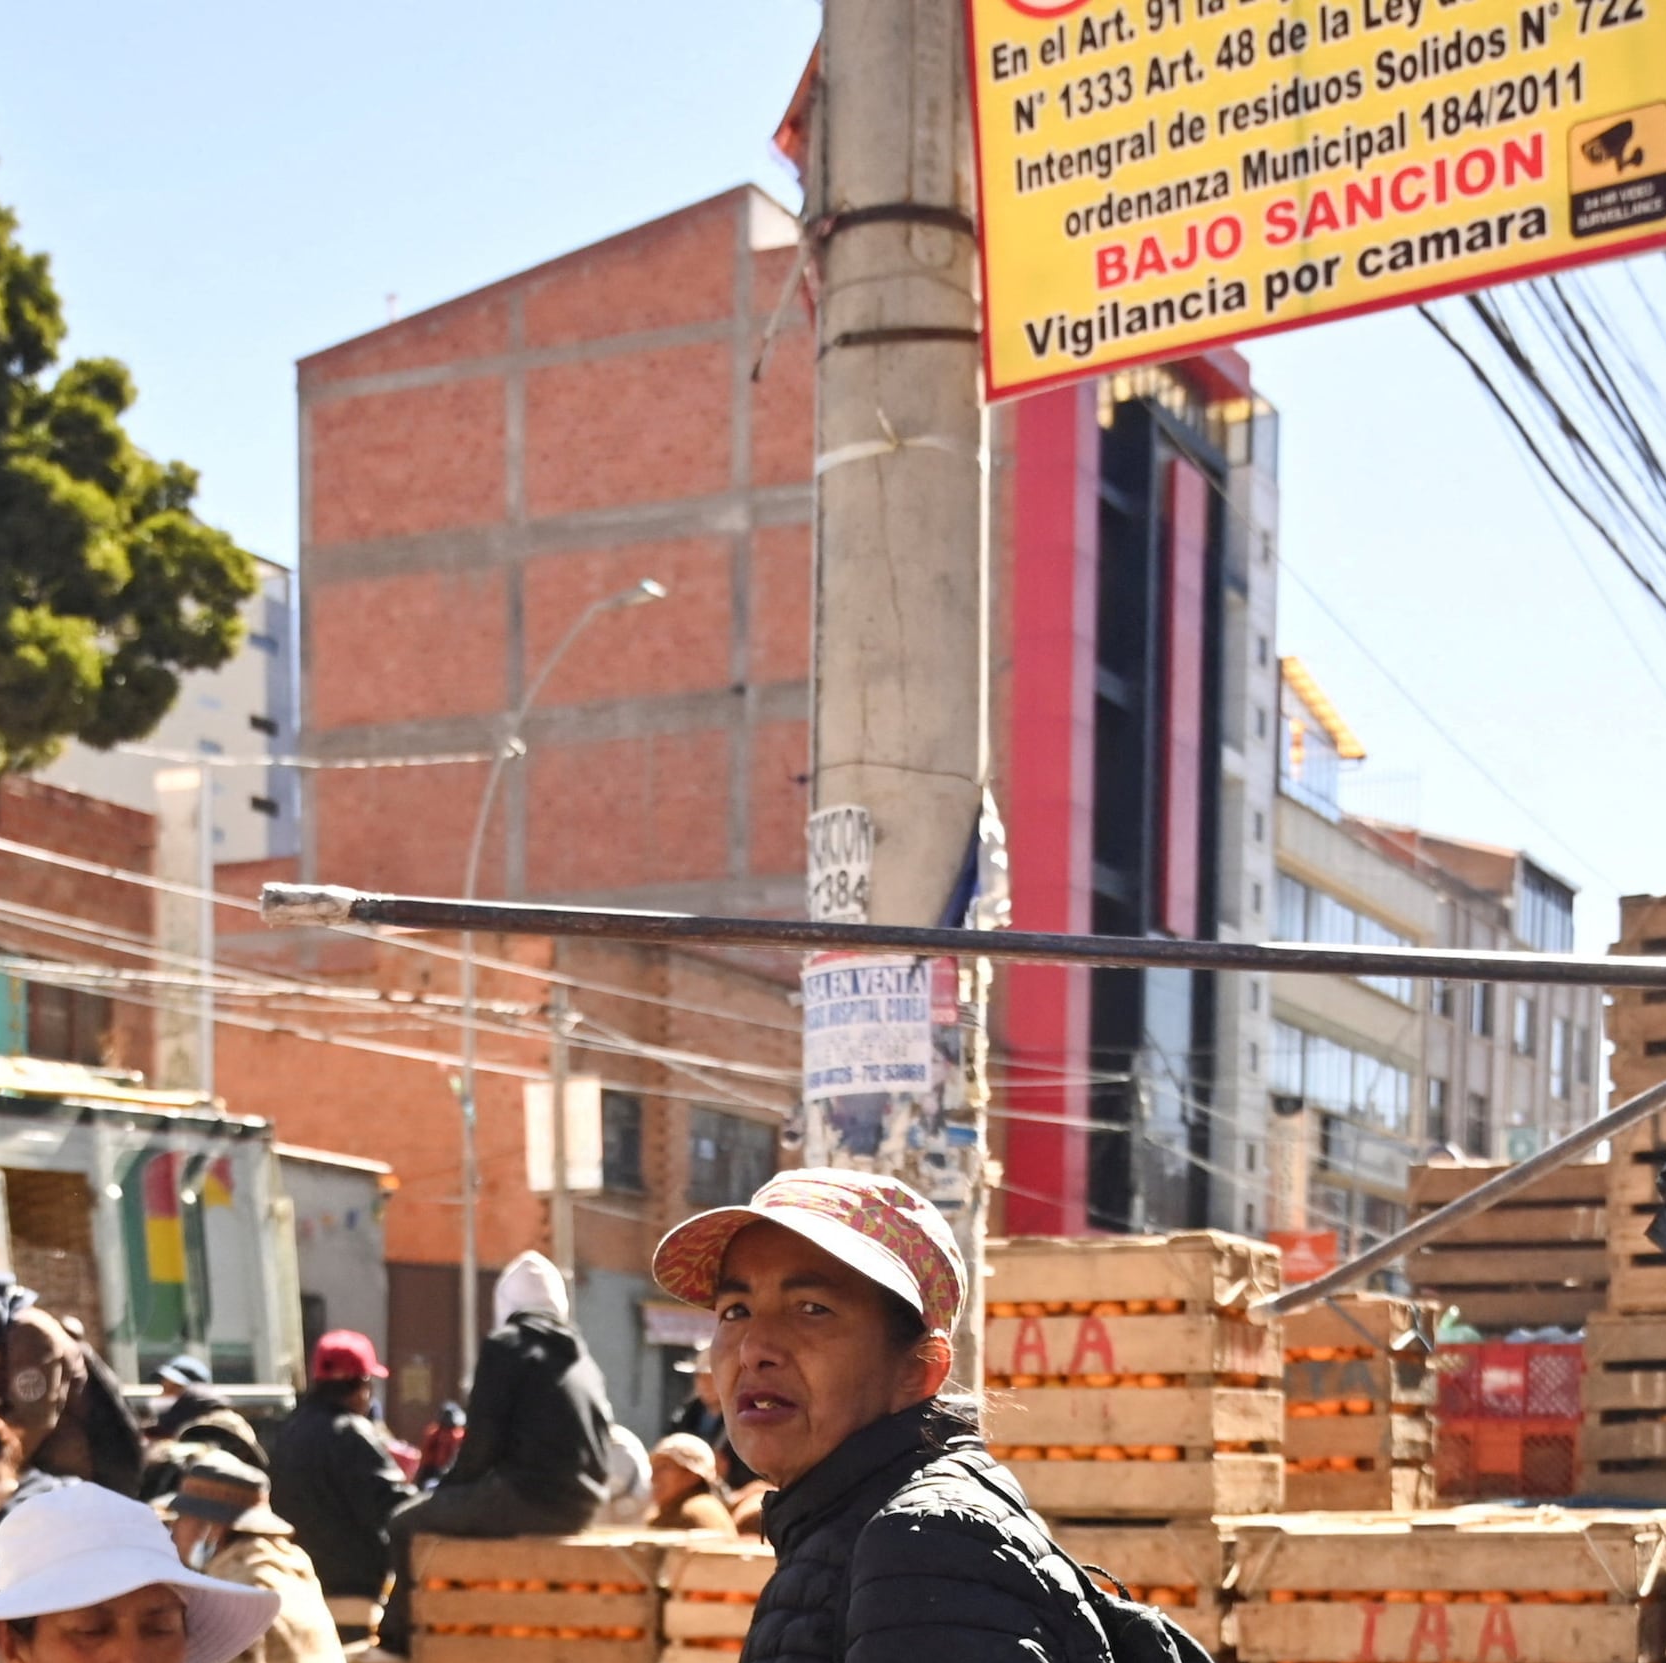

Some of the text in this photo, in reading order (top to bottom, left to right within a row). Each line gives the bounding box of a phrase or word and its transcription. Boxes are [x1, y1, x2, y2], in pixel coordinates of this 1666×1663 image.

[992, 43, 1029, 81] En
[1039, 26, 1065, 66] el
[1078, 15, 1135, 54] Art.
[1147, 0, 1184, 33] 91
[1015, 119, 1157, 194] Intengral
[1168, 111, 1206, 150] de
[1218, 70, 1363, 136] residuos
[1375, 28, 1506, 91] Solidos
[1059, 65, 1133, 120] 1333
[1145, 48, 1204, 96] Art.
[1216, 28, 1255, 71] 48
[1268, 18, 1307, 59] de
[1320, 4, 1349, 43] la
[1364, 0, 1421, 32] Ley
[1064, 61, 1583, 237] ordenanza Municipal 184/2011
[1095, 132, 1545, 290] BAJO SANCION
[1024, 205, 1547, 358] Vigilancia por camara
